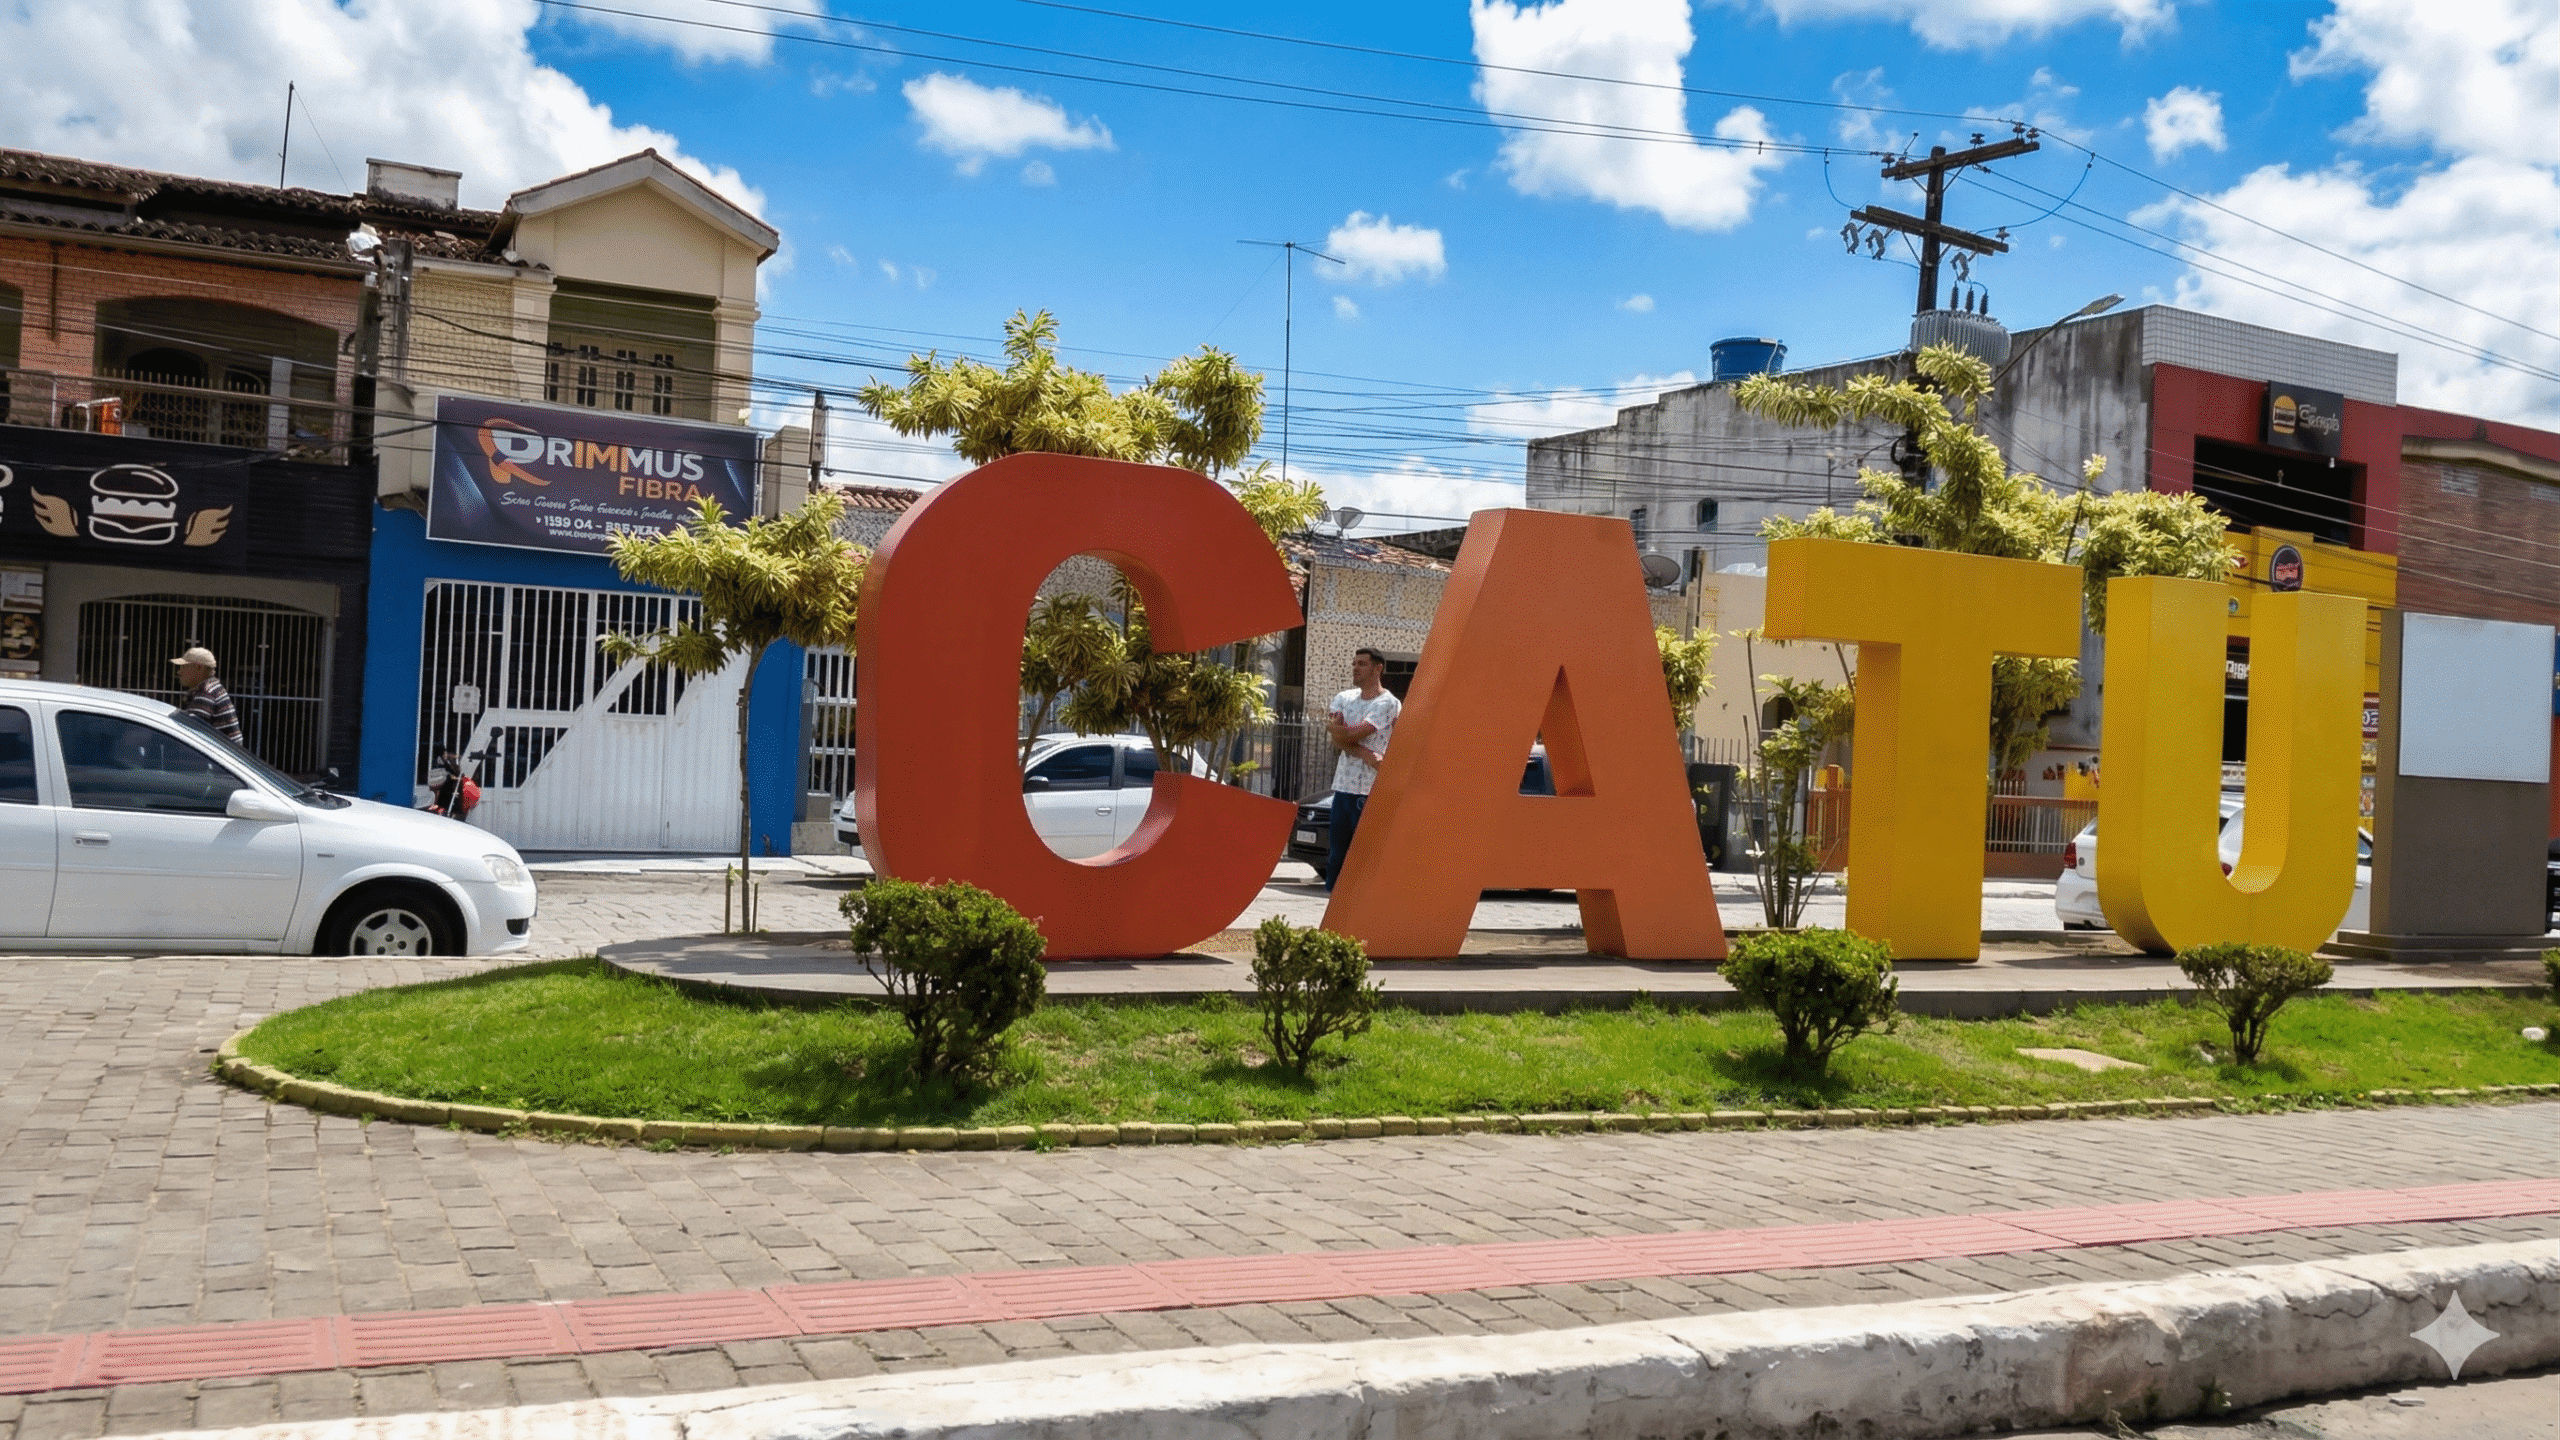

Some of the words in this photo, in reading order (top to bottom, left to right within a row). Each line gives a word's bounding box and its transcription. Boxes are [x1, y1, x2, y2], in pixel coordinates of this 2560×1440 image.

[478, 418, 704, 485] PRIMMUS
[619, 476, 701, 502] FIBRA
[856, 453, 2368, 962] CATU
